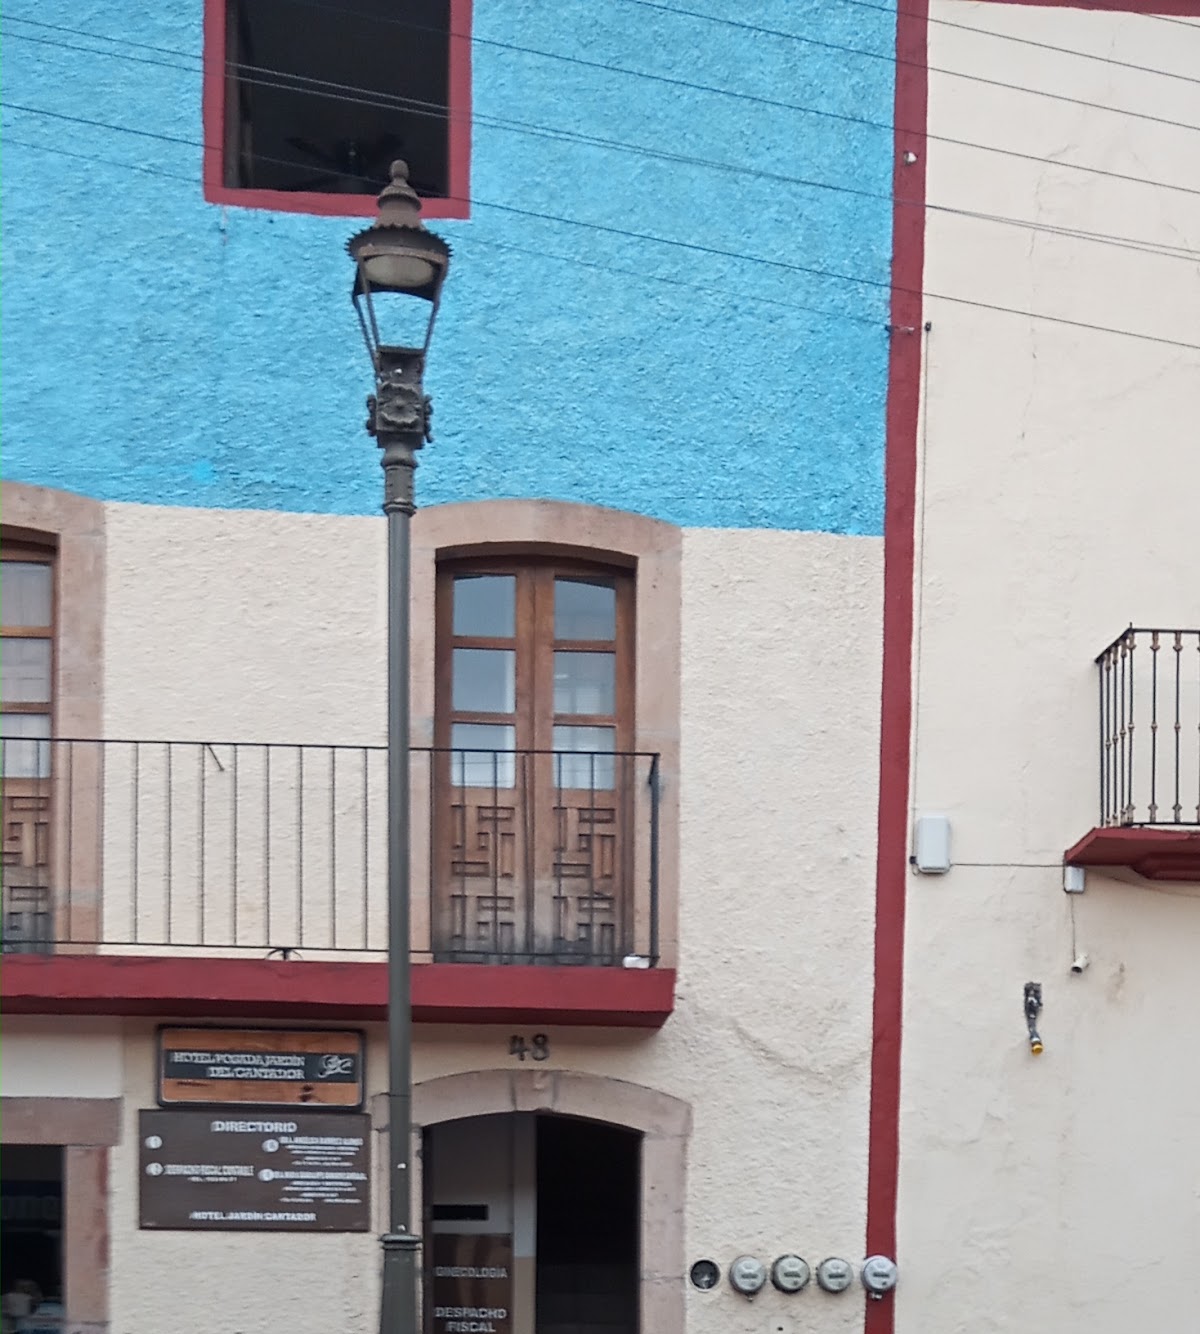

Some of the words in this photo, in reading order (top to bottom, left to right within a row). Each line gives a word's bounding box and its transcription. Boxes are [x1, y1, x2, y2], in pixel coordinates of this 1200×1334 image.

[509, 1033, 549, 1062] 48
[171, 1052, 215, 1064] HOTEL
[207, 1066, 234, 1078] DEL
[234, 1067, 305, 1079] CANTADOR
[210, 1120, 297, 1133] DIRECTORIO
[190, 1211, 226, 1221] HOTEL
[263, 1212, 317, 1222] CANTADOR
[435, 1306, 507, 1319] DESPACHO
[446, 1321, 497, 1333] FISCAL
